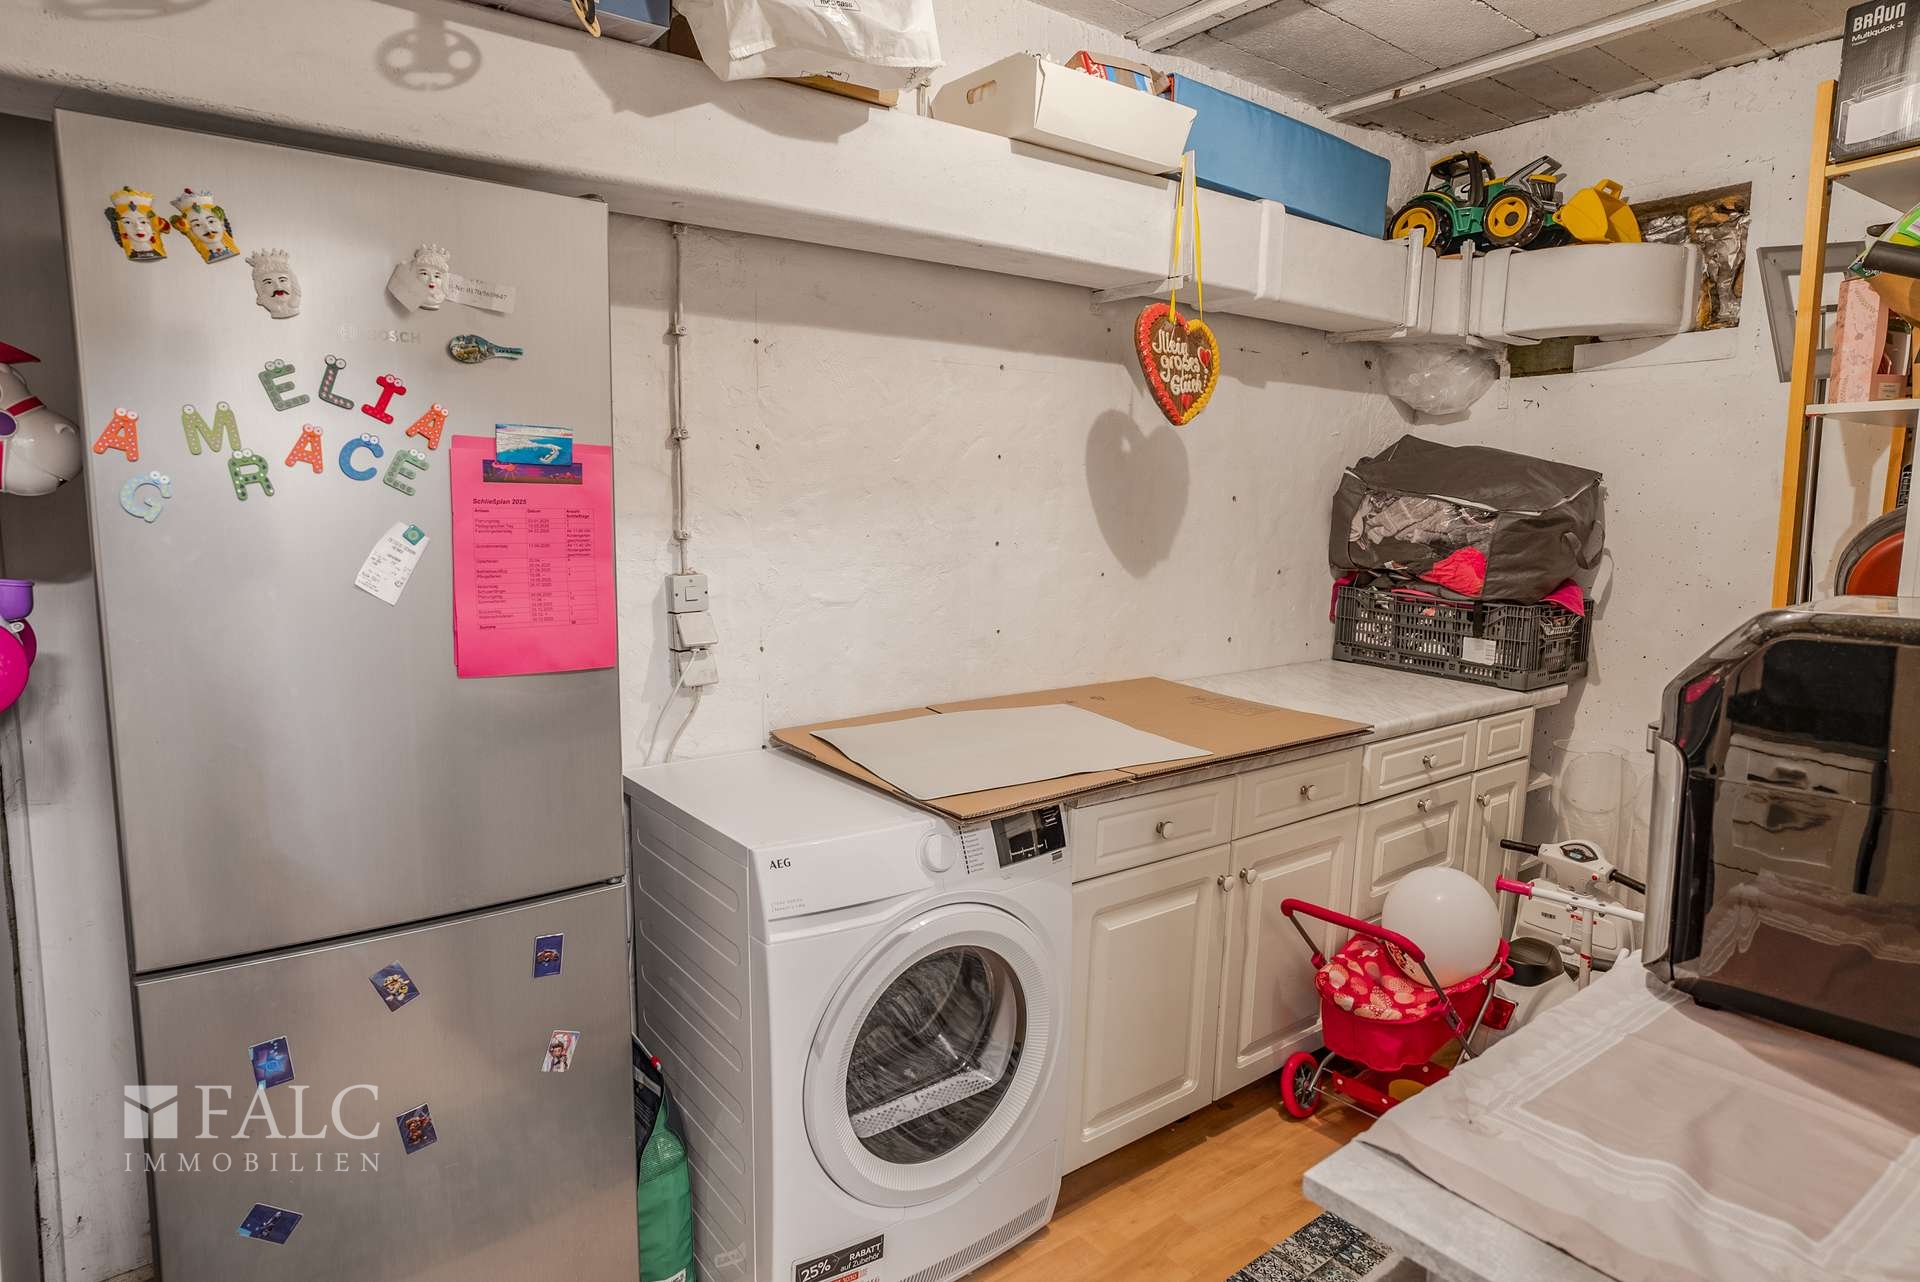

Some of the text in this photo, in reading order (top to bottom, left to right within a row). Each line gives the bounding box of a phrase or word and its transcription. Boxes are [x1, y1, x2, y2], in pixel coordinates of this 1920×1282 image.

[1853, 2, 1906, 32] BRAUN
[1851, 20, 1904, 42] Multiquick 3
[1152, 329, 1188, 356] Mein
[472, 498, 511, 506] Schließplan
[769, 857, 791, 870] AEG
[848, 1244, 881, 1260] RABATT
[801, 1260, 831, 1282] 25%
[840, 1253, 880, 1272] auf Zubehör
